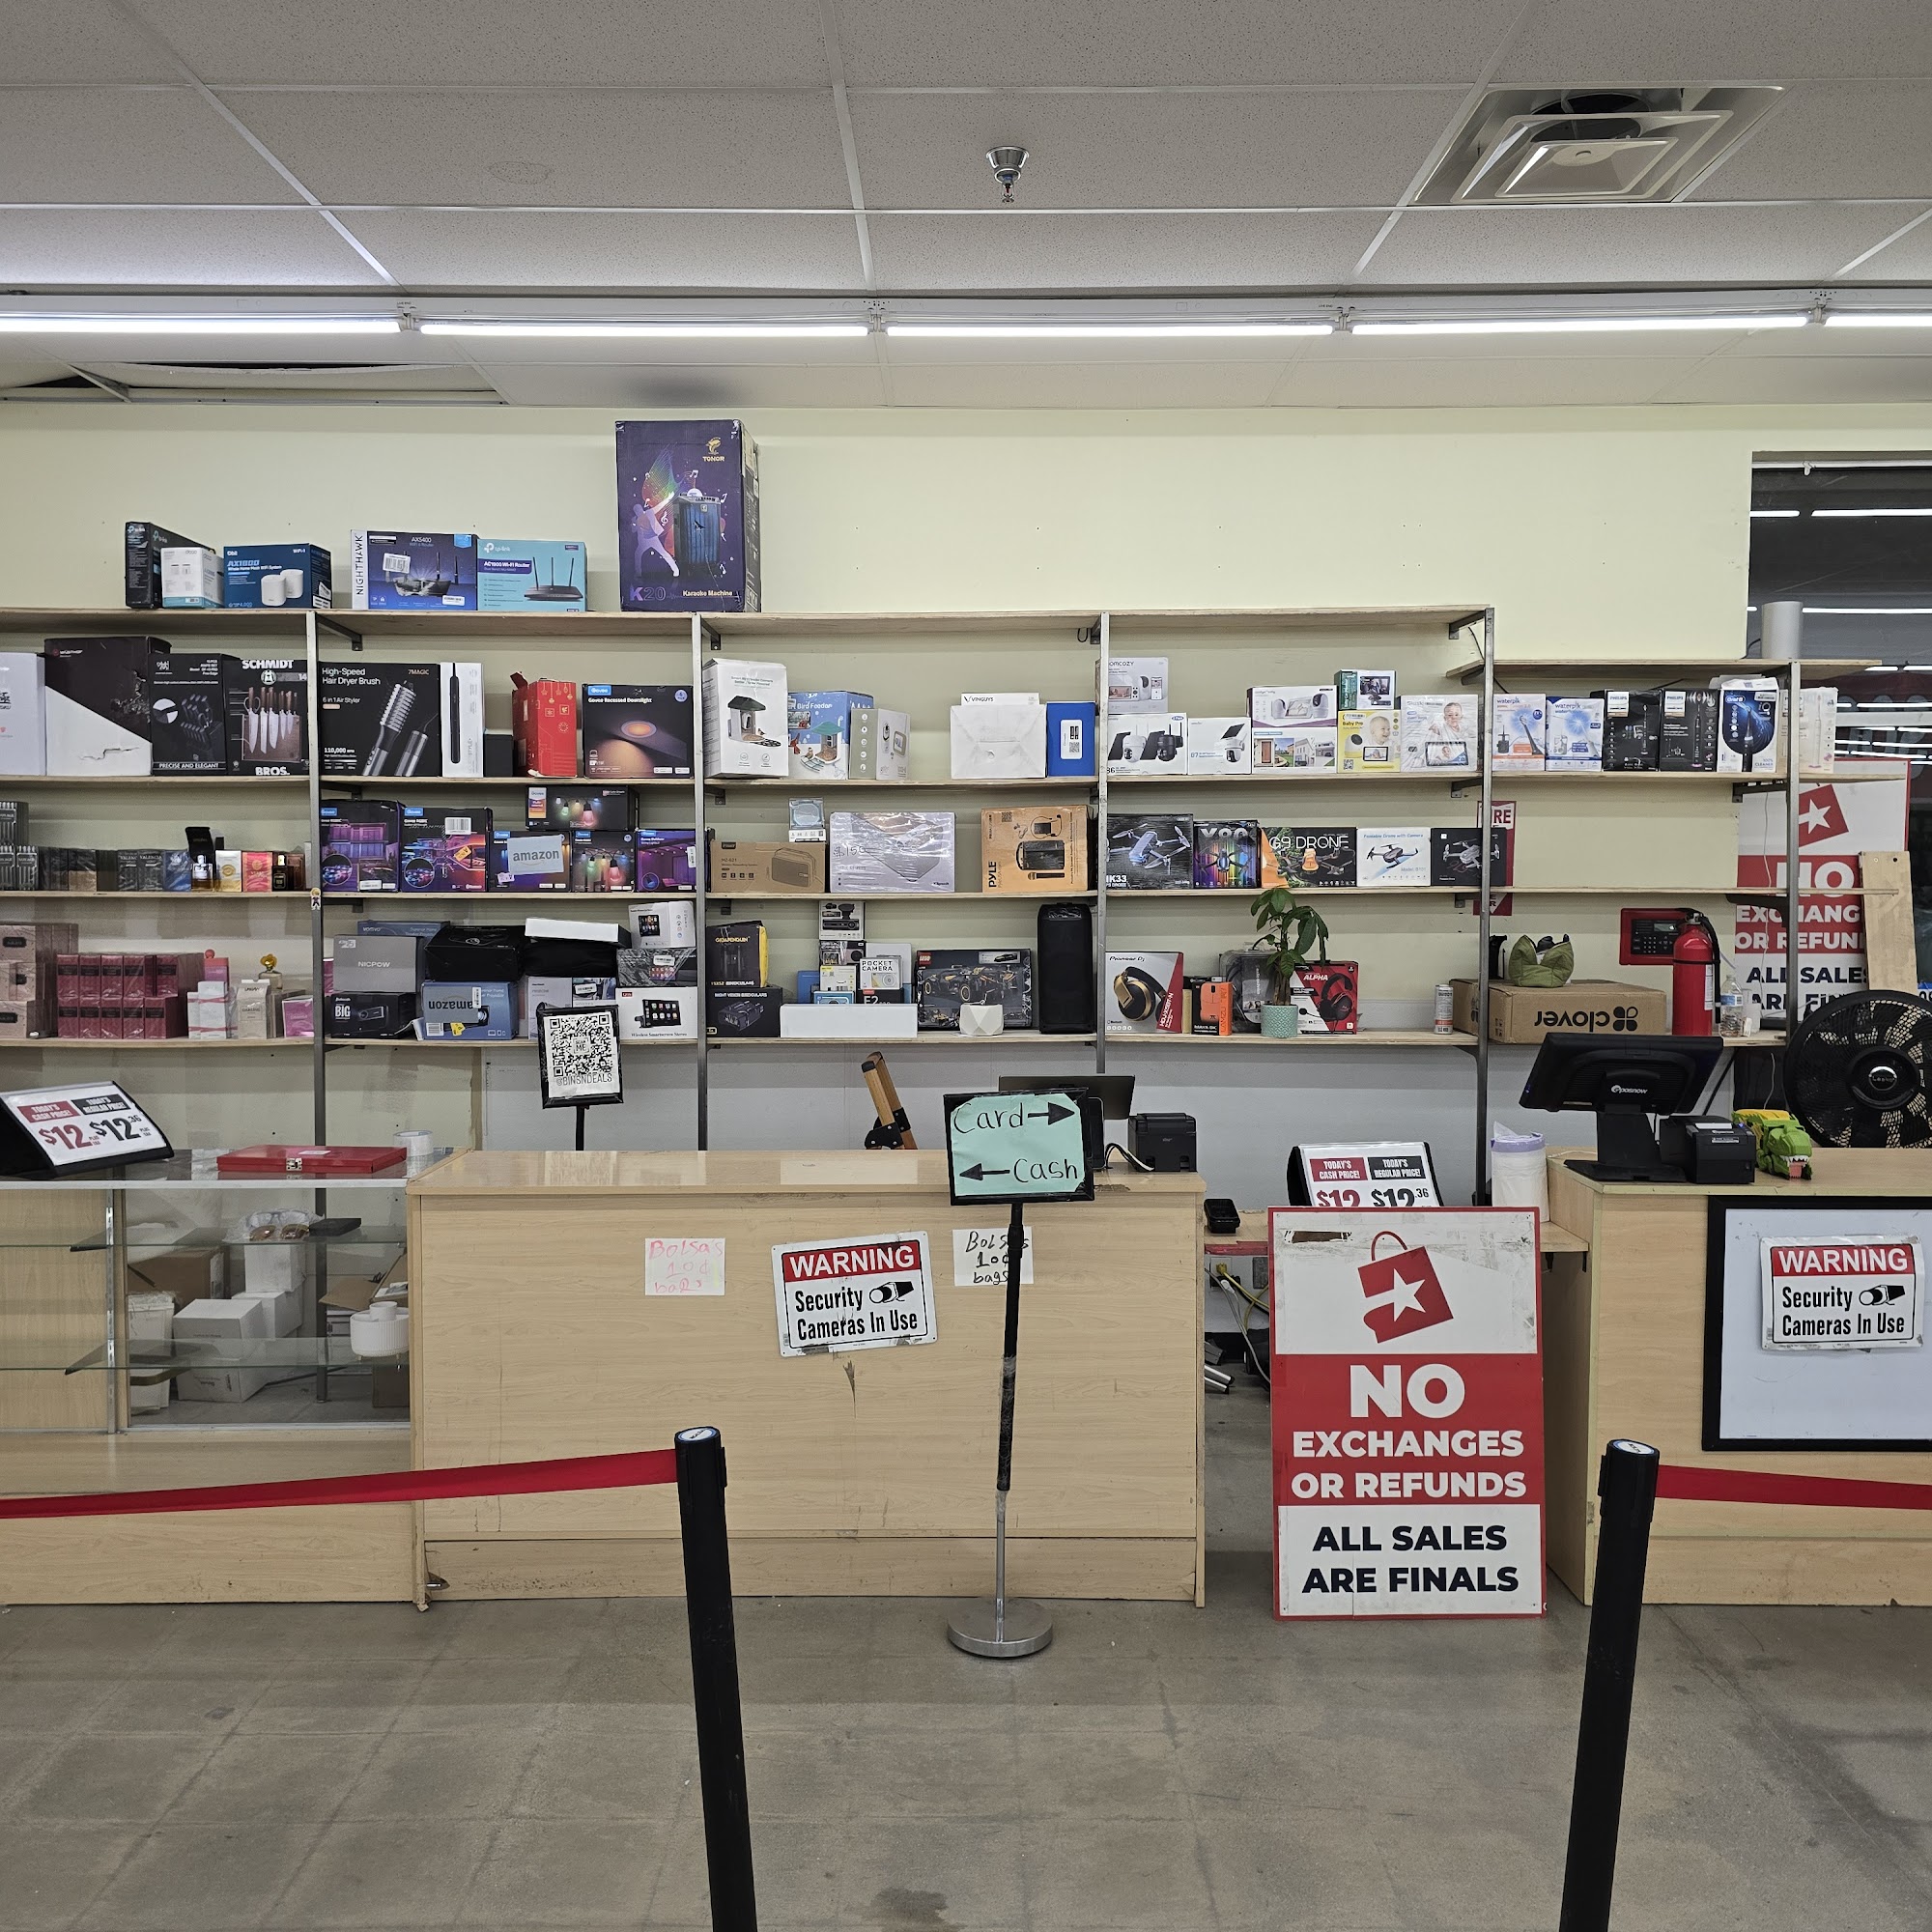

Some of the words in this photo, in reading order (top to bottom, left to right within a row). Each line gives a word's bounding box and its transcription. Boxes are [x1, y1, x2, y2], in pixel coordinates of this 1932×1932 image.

[355, 535, 364, 596] NIGHTHAWK
[630, 586, 667, 601] K20
[242, 660, 294, 669] SCHMIDT
[322, 668, 366, 677] High-Speed
[338, 677, 358, 687] Dryer
[255, 767, 291, 776] BROS.
[1296, 836, 1350, 849] DRONE
[513, 849, 559, 863] amazon
[988, 862, 997, 888] PYLE
[1734, 932, 1769, 950] OR
[335, 1006, 351, 1017] BIG
[428, 1000, 473, 1009] amazon
[1535, 1011, 1609, 1033] clover
[556, 1073, 612, 1086] @BINSNDEALS
[50, 1110, 71, 1119] PRICE!
[953, 1102, 1024, 1133] Card
[39, 1123, 93, 1150] $12
[1014, 1158, 1078, 1183] Cash
[1323, 1160, 1351, 1170] TODAY'S
[1374, 1169, 1401, 1179] REGULAR
[1401, 1168, 1421, 1178] PRICE!
[1382, 1159, 1408, 1168] TODAY'S
[1319, 1170, 1338, 1179] CASH
[1339, 1170, 1361, 1179] PRICE!
[1317, 1189, 1360, 1208] $12
[789, 1245, 915, 1278] WARNING
[1778, 1247, 1909, 1273] WARNING
[795, 1286, 863, 1312] Security
[1782, 1286, 1853, 1312] Security
[797, 1318, 866, 1341] Cameras
[870, 1311, 886, 1333] In
[890, 1309, 918, 1331] Use
[1782, 1314, 1851, 1337] Cameras
[1857, 1313, 1871, 1334] In
[1877, 1313, 1905, 1333] Use
[1350, 1363, 1465, 1418] NO
[1293, 1430, 1524, 1458] EXCHANGES
[1291, 1472, 1344, 1498] OR
[1355, 1471, 1526, 1498] REFUNDS
[1312, 1526, 1381, 1551] ALL
[1392, 1525, 1507, 1551] SALES
[1302, 1567, 1377, 1594] ARE
[1389, 1567, 1520, 1593] FINALS
